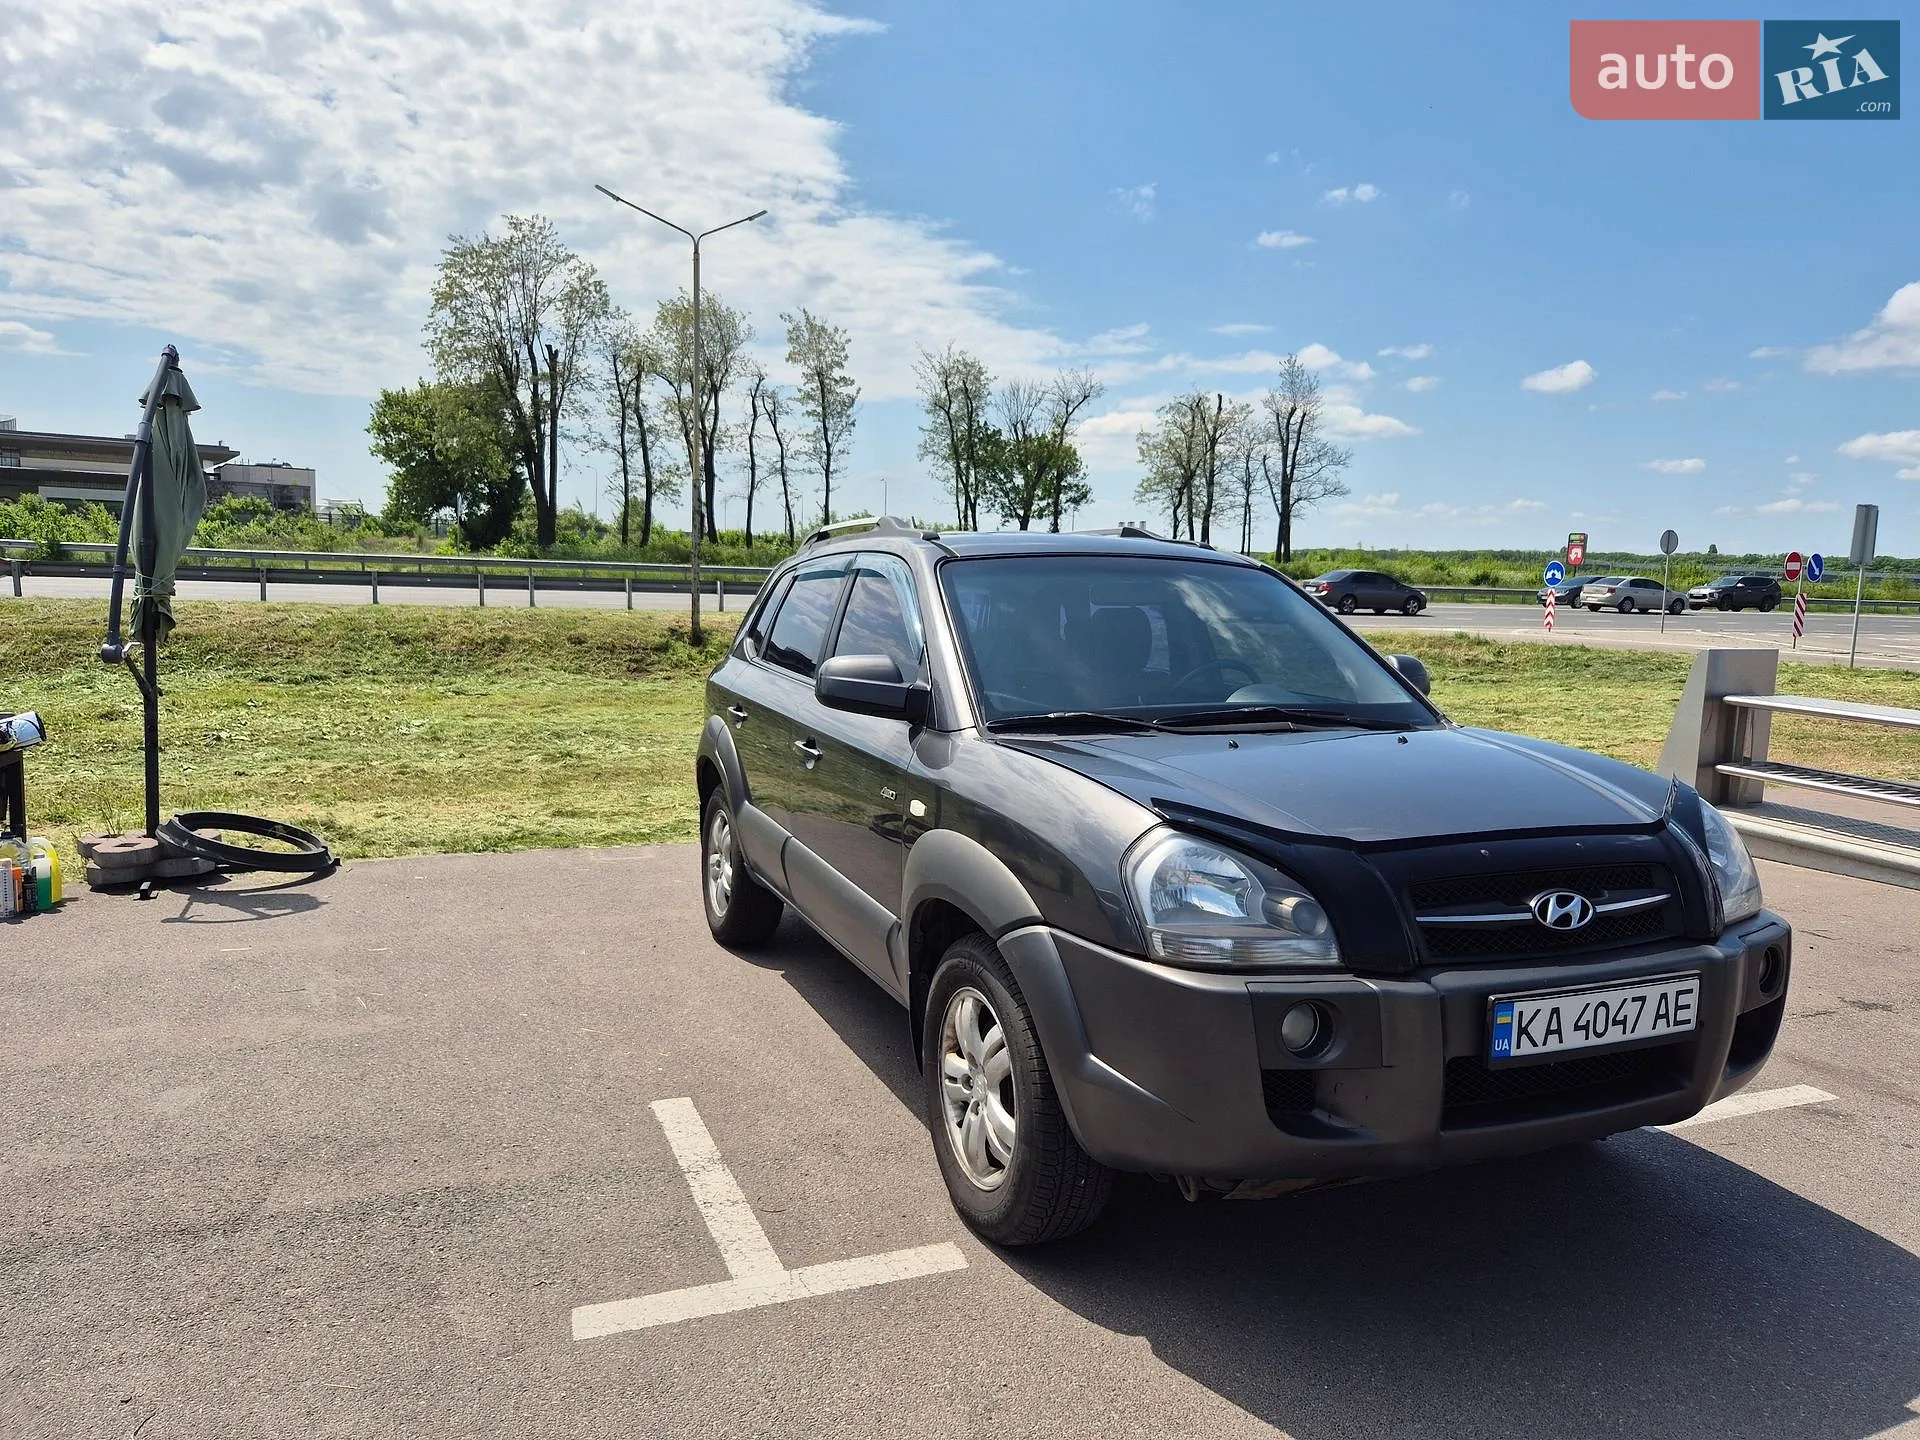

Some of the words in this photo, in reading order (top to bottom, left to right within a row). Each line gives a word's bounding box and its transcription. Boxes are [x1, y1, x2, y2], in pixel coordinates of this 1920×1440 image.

[1516, 1007, 1563, 1049] KA
[1573, 995, 1647, 1041] 4047
[1651, 988, 1694, 1031] AE
[1495, 1038, 1510, 1051] UA
